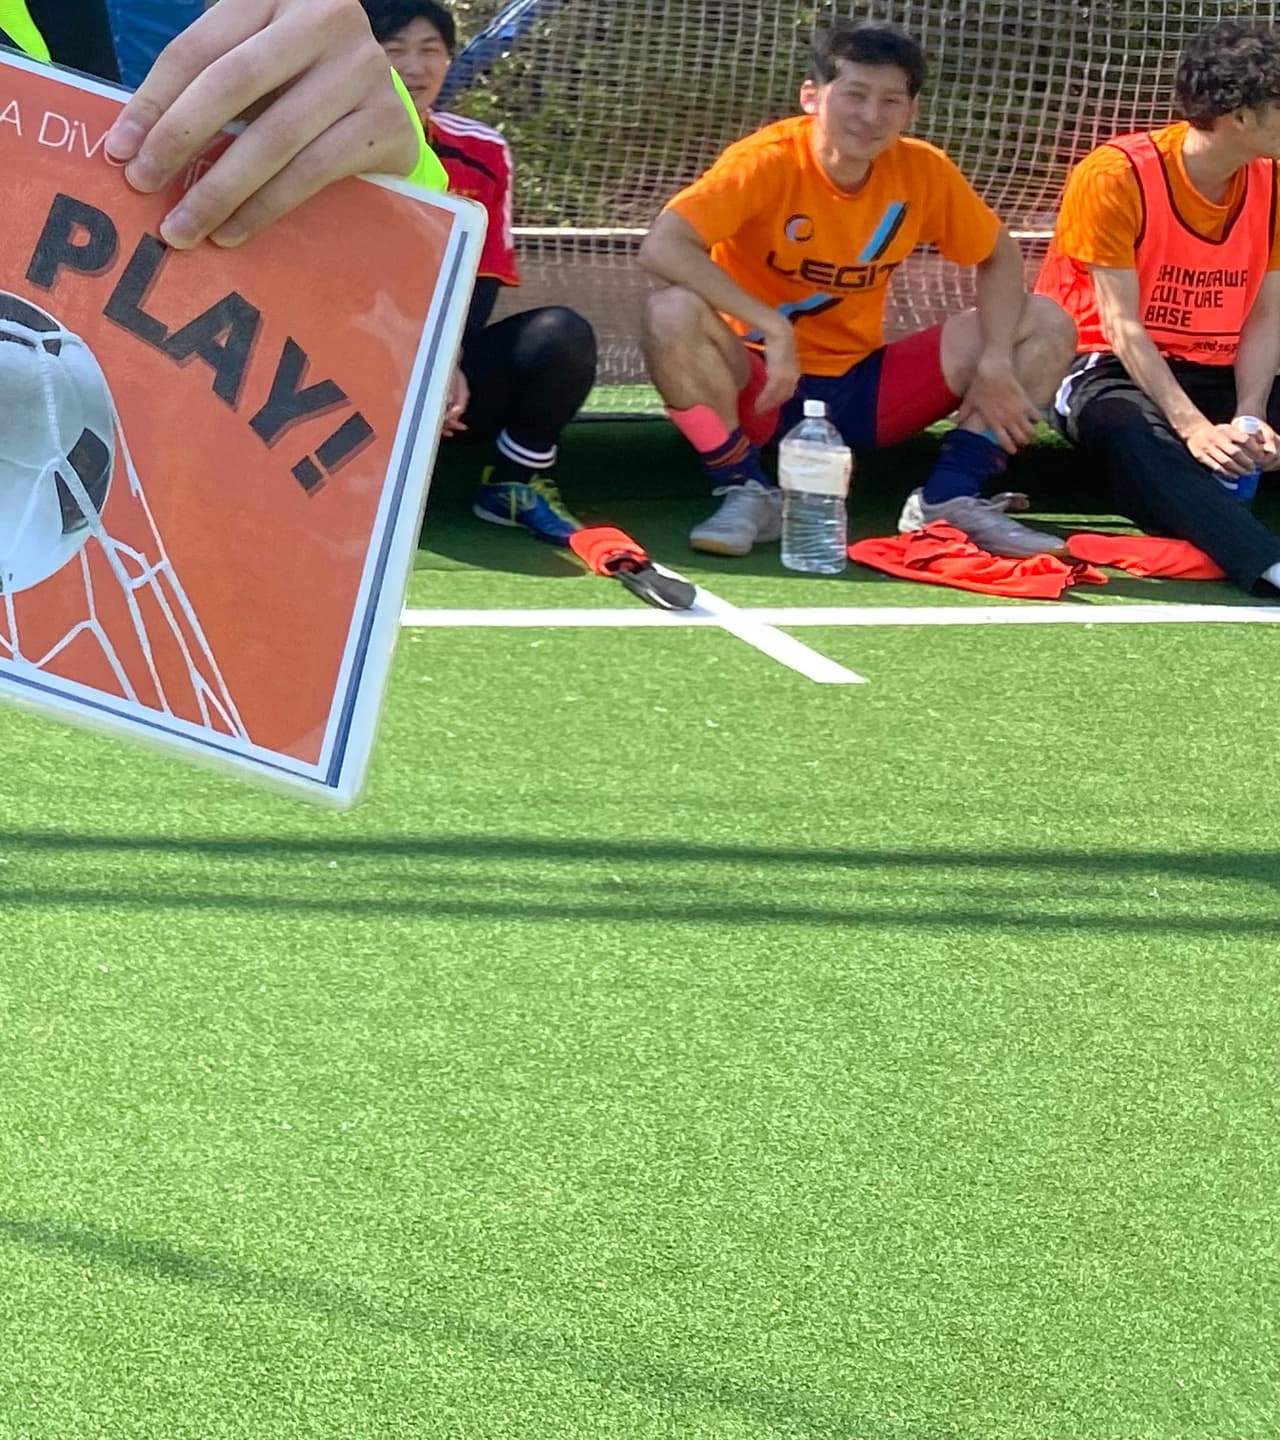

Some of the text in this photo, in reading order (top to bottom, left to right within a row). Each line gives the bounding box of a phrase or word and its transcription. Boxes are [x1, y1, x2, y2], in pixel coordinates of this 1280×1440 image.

[38, 111, 129, 167] DiV
[1144, 305, 1192, 328] BASE
[1150, 285, 1224, 309] CULTURE
[25, 192, 376, 496] PLAY!
